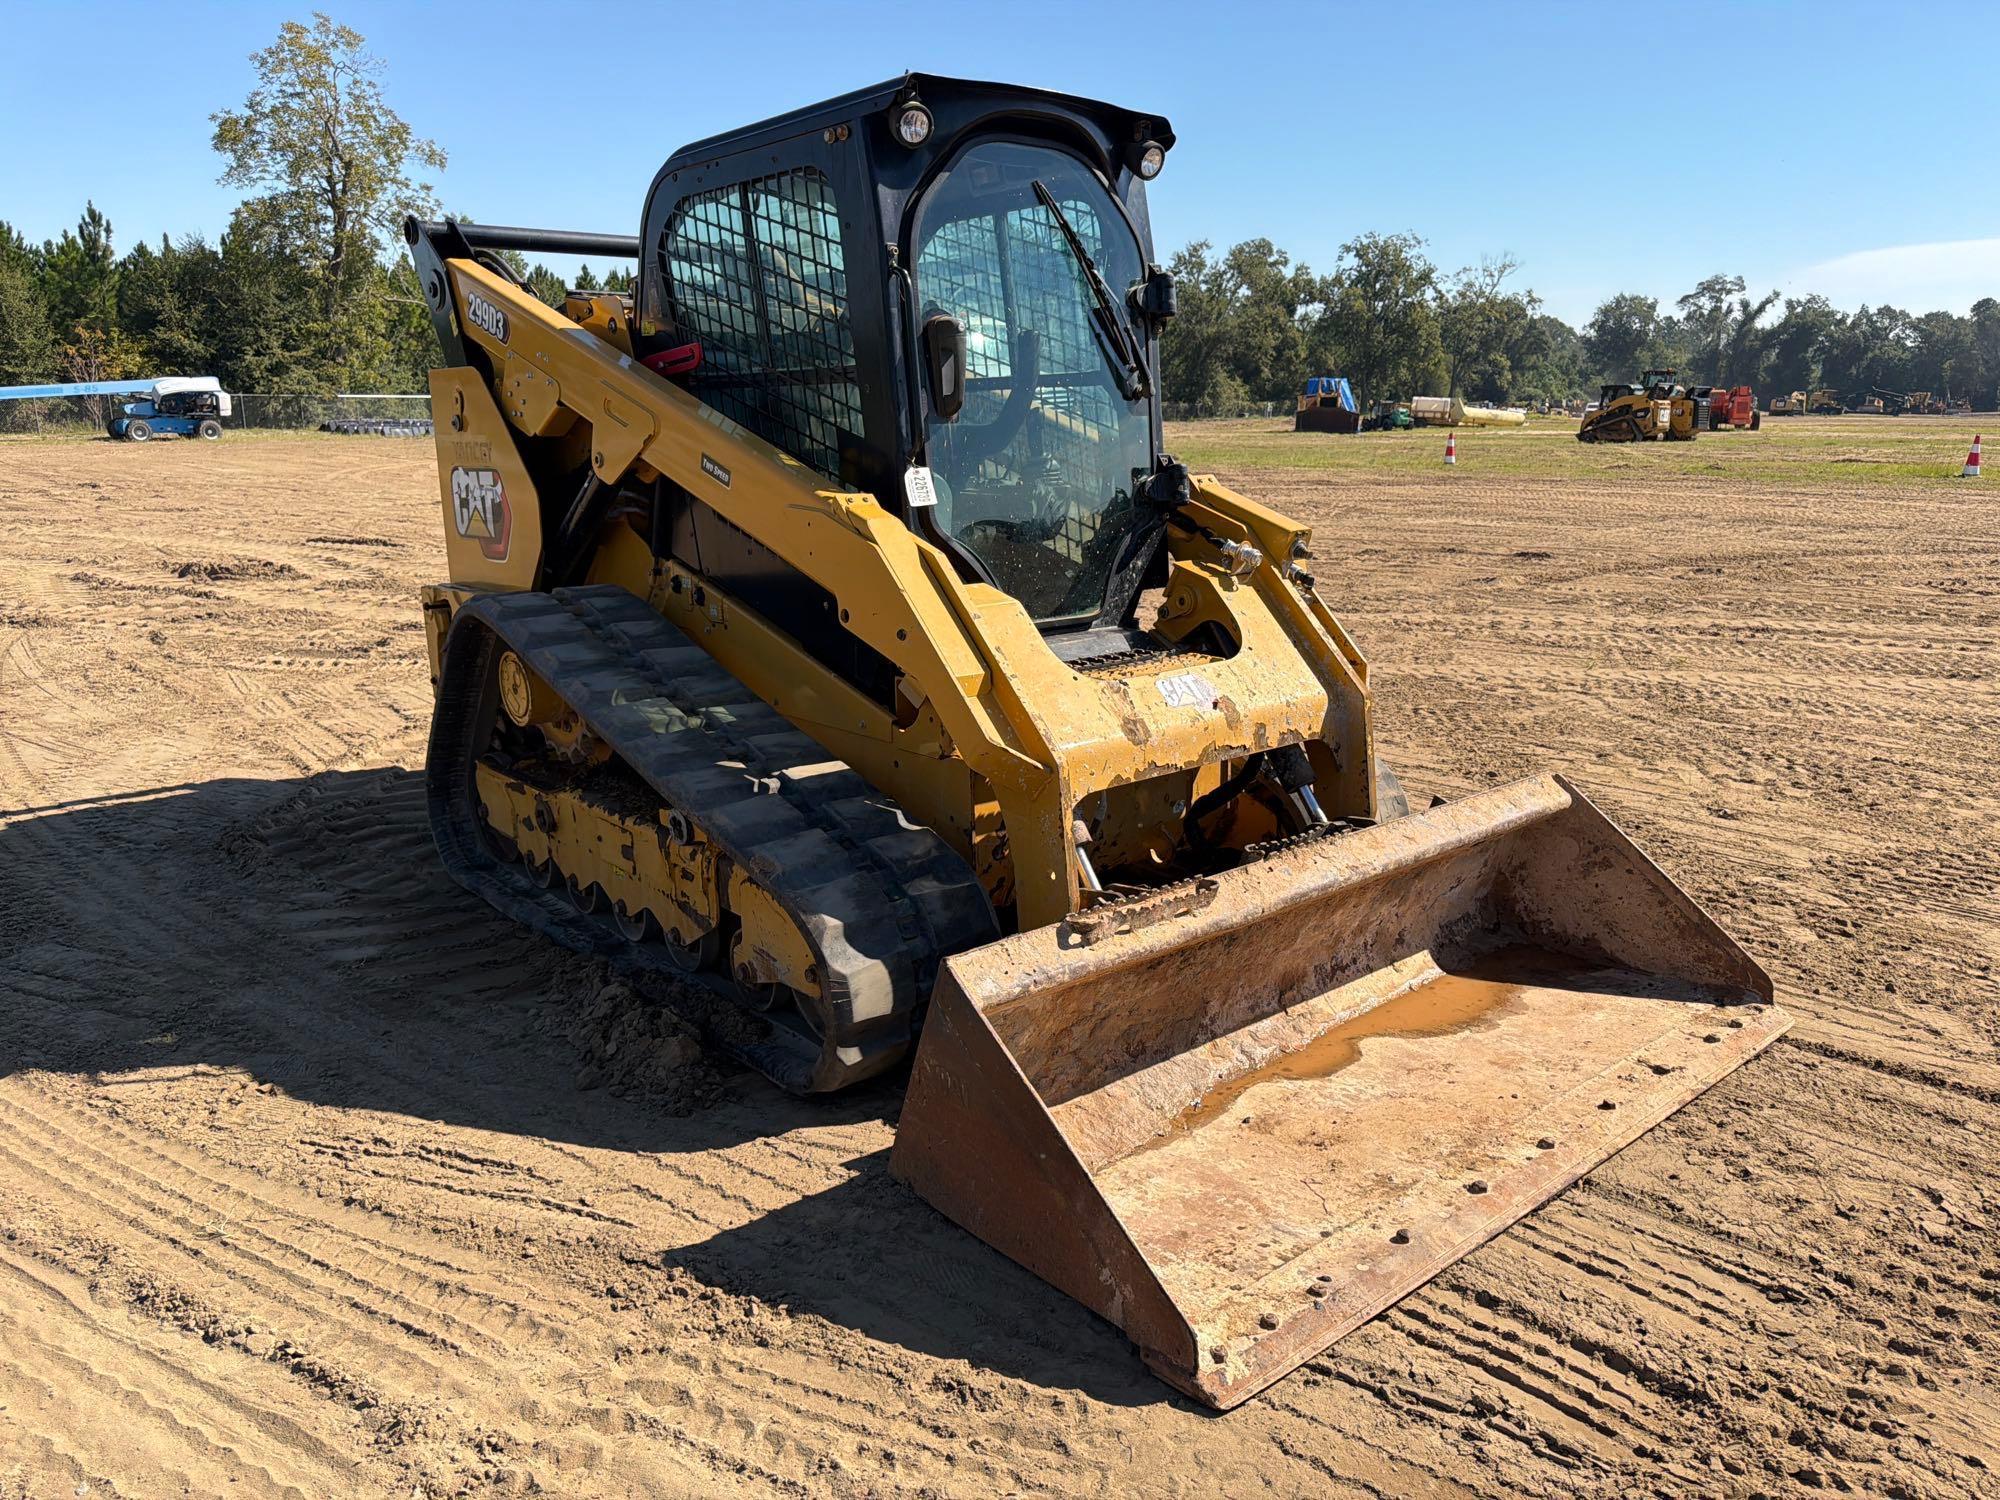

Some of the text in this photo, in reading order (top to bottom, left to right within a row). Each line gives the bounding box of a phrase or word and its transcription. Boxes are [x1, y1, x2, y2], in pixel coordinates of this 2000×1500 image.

[468, 292, 504, 340] 299D3
[452, 466, 500, 538] CAT
[1155, 674, 1204, 707] CAT
